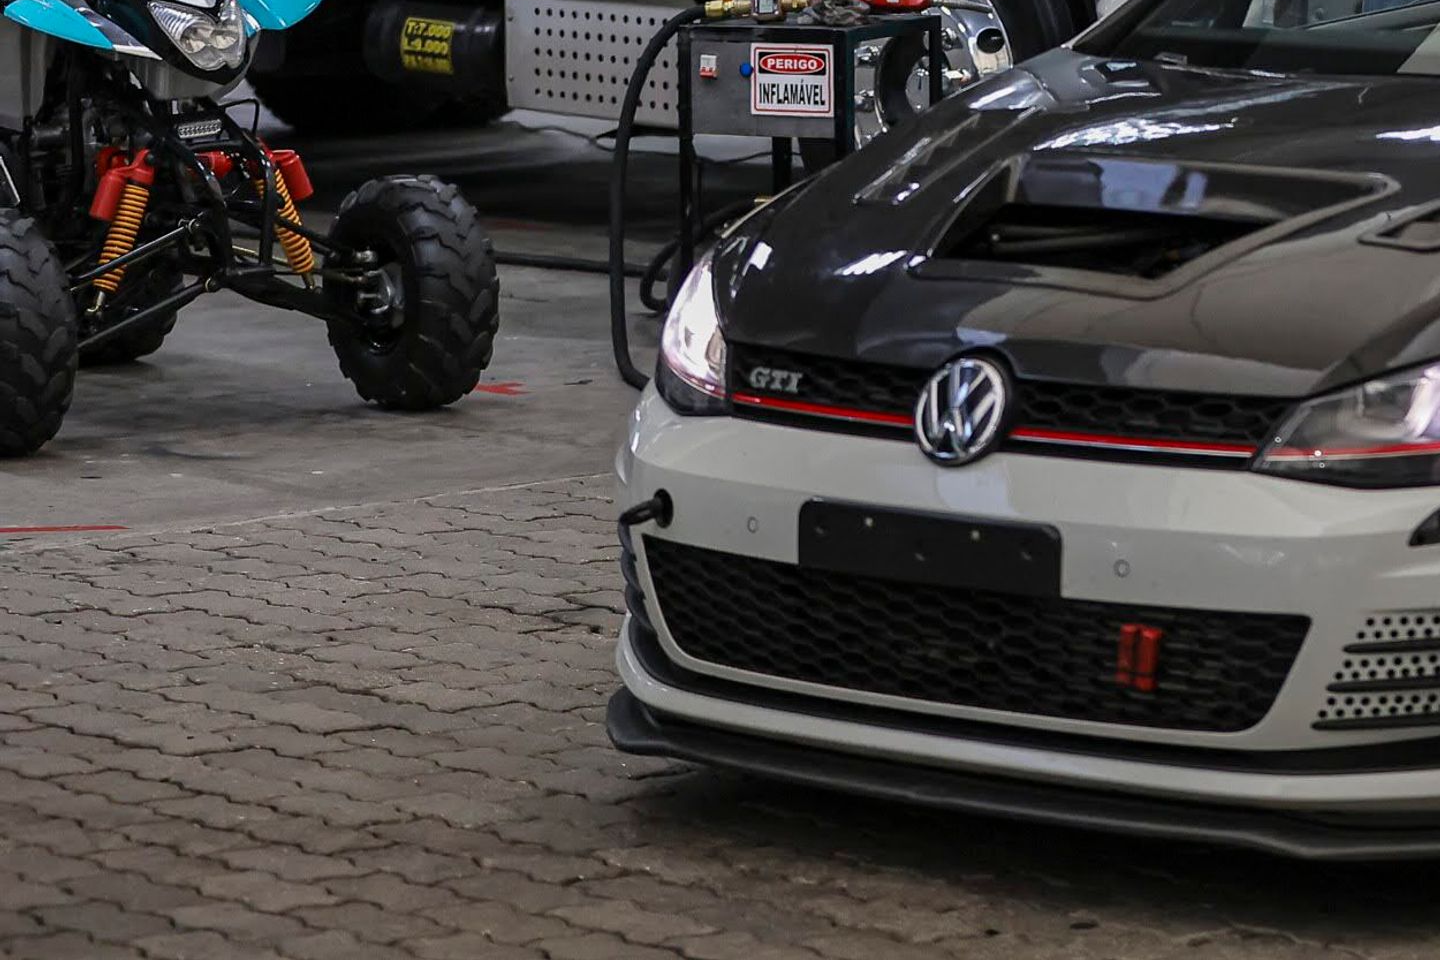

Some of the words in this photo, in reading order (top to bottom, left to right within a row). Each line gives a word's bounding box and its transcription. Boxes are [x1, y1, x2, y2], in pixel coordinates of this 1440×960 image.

[767, 58, 818, 70] PERIGO
[759, 79, 825, 106] INFLAMÁVEL
[750, 367, 803, 394] GTI
